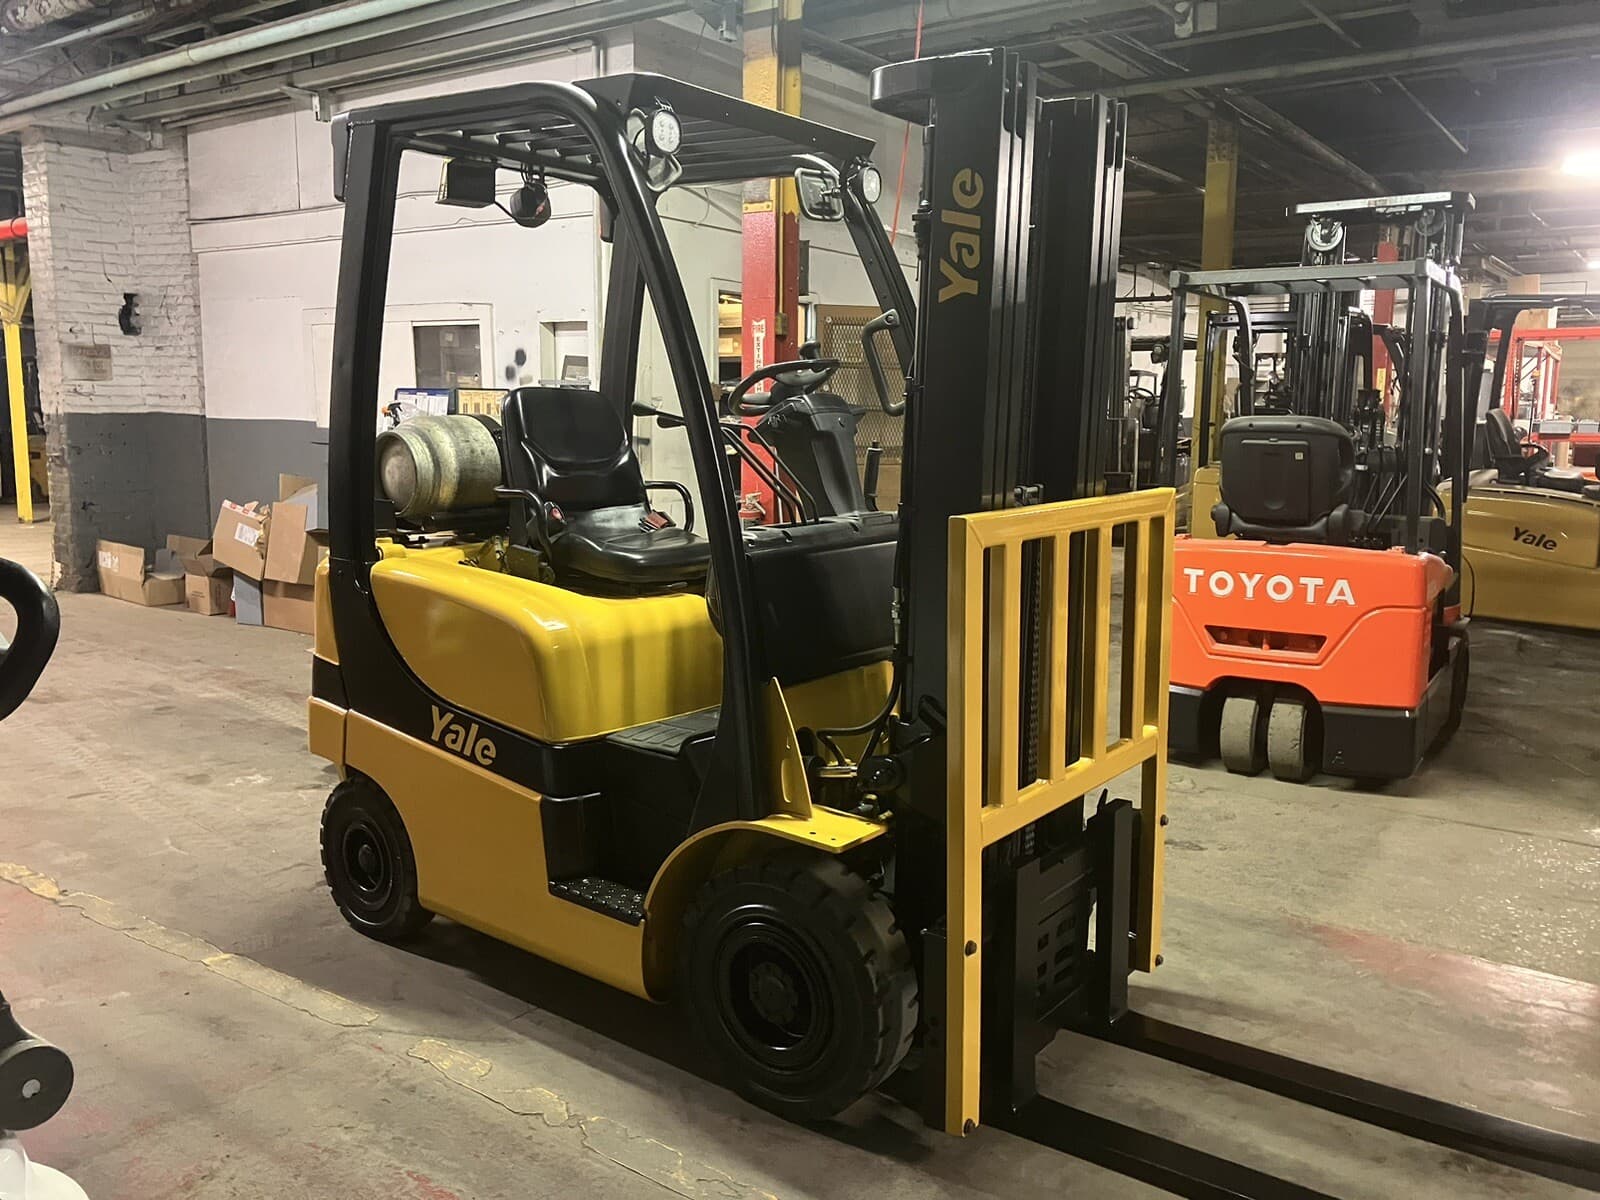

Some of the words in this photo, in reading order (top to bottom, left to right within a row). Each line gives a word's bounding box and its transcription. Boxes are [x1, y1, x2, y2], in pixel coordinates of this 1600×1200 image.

[938, 167, 984, 303] Yale
[1513, 526, 1557, 550] Yale
[1183, 567, 1356, 606] TOYOTA
[431, 704, 497, 766] Yale
